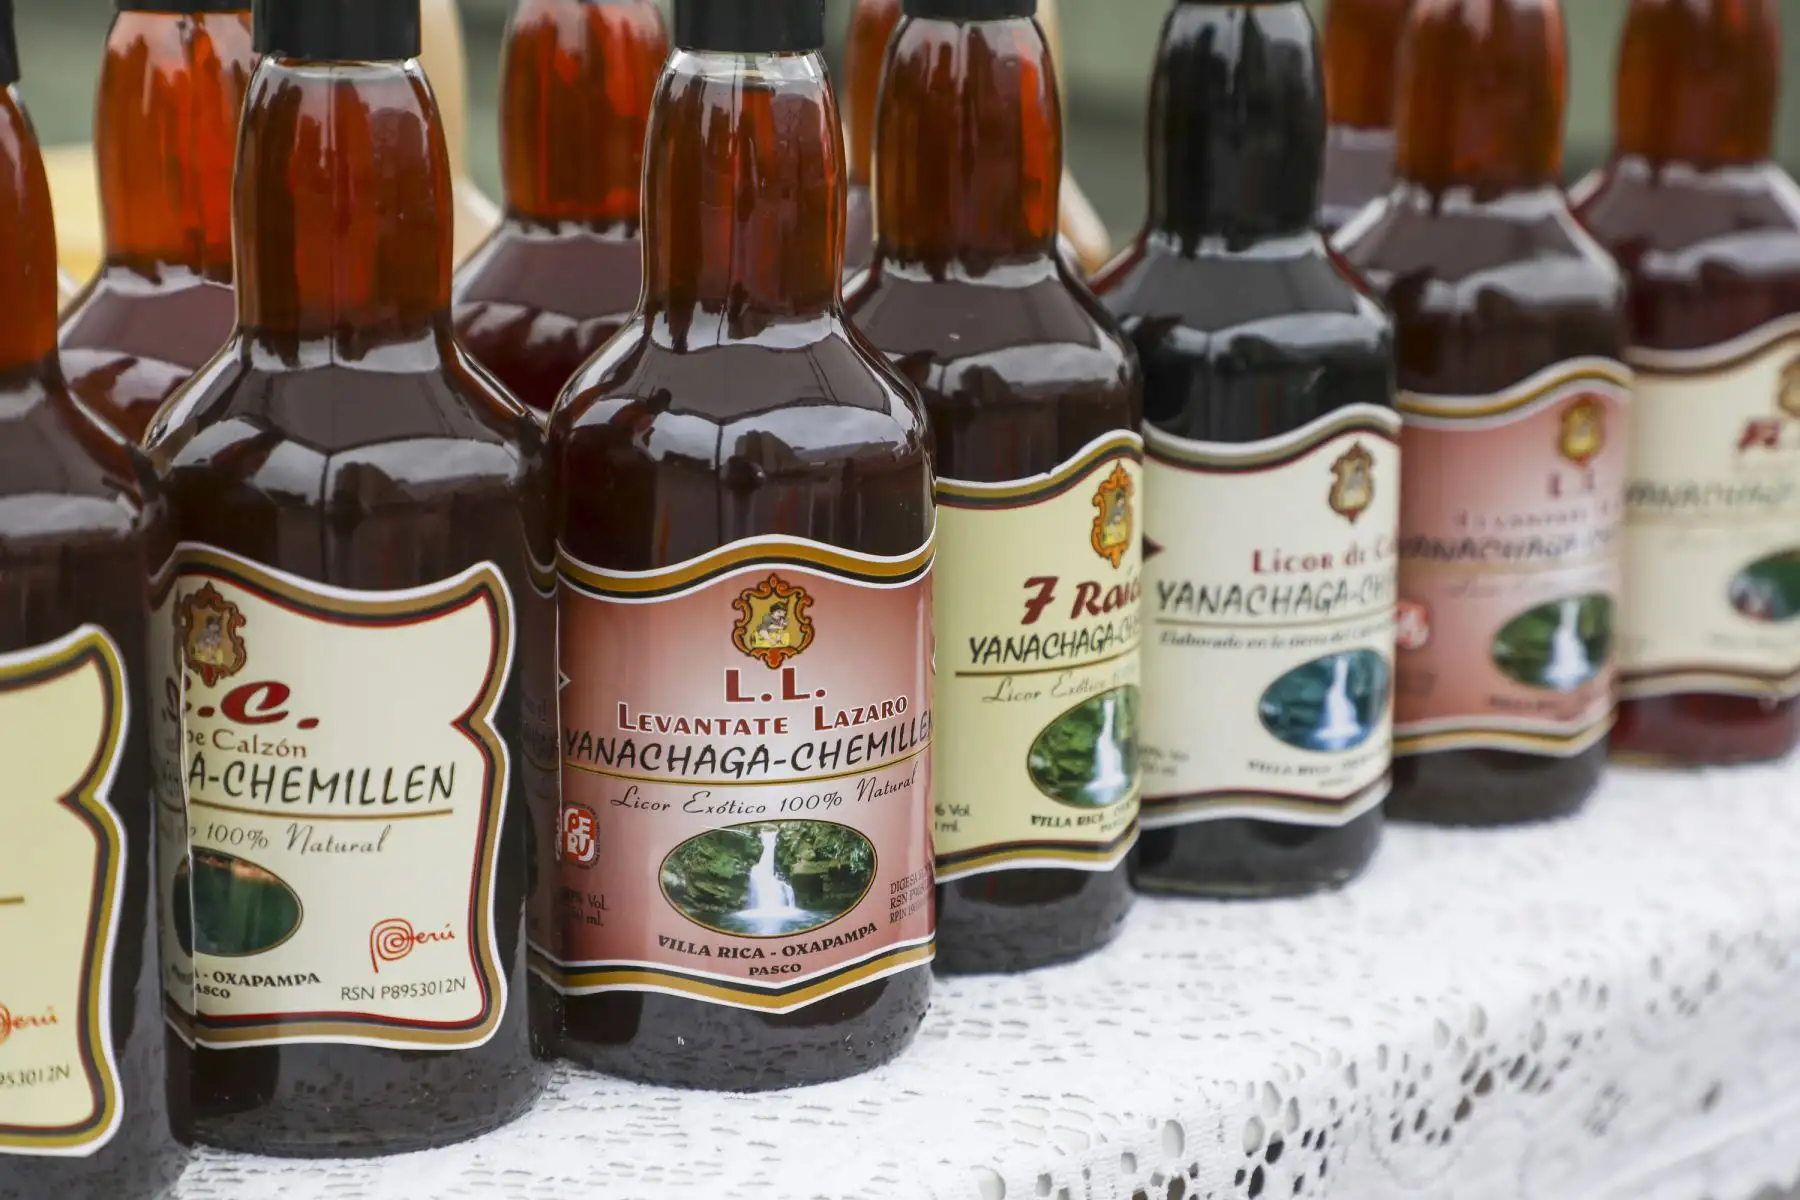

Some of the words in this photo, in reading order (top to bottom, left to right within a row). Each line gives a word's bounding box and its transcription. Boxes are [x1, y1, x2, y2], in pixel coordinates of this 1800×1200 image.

[1020, 575, 1060, 626] 7
[724, 666, 828, 704] L.L.
[981, 675, 1042, 704] Licor
[212, 728, 308, 758] Calzón
[610, 785, 672, 812] Licor
[682, 790, 767, 816] Exótico
[779, 791, 843, 814] 100%
[856, 760, 919, 803] Natural
[206, 823, 269, 849] 100%
[286, 821, 392, 856] Natural
[889, 891, 908, 910] RSN
[657, 934, 712, 957] VILLA
[716, 946, 766, 959] RICA
[781, 922, 878, 957] OXAPAMPA
[212, 970, 321, 988] OXAPAMPA
[748, 963, 802, 976] PASCO
[341, 985, 376, 1001] RSN
[381, 975, 467, 999] P8953012N
